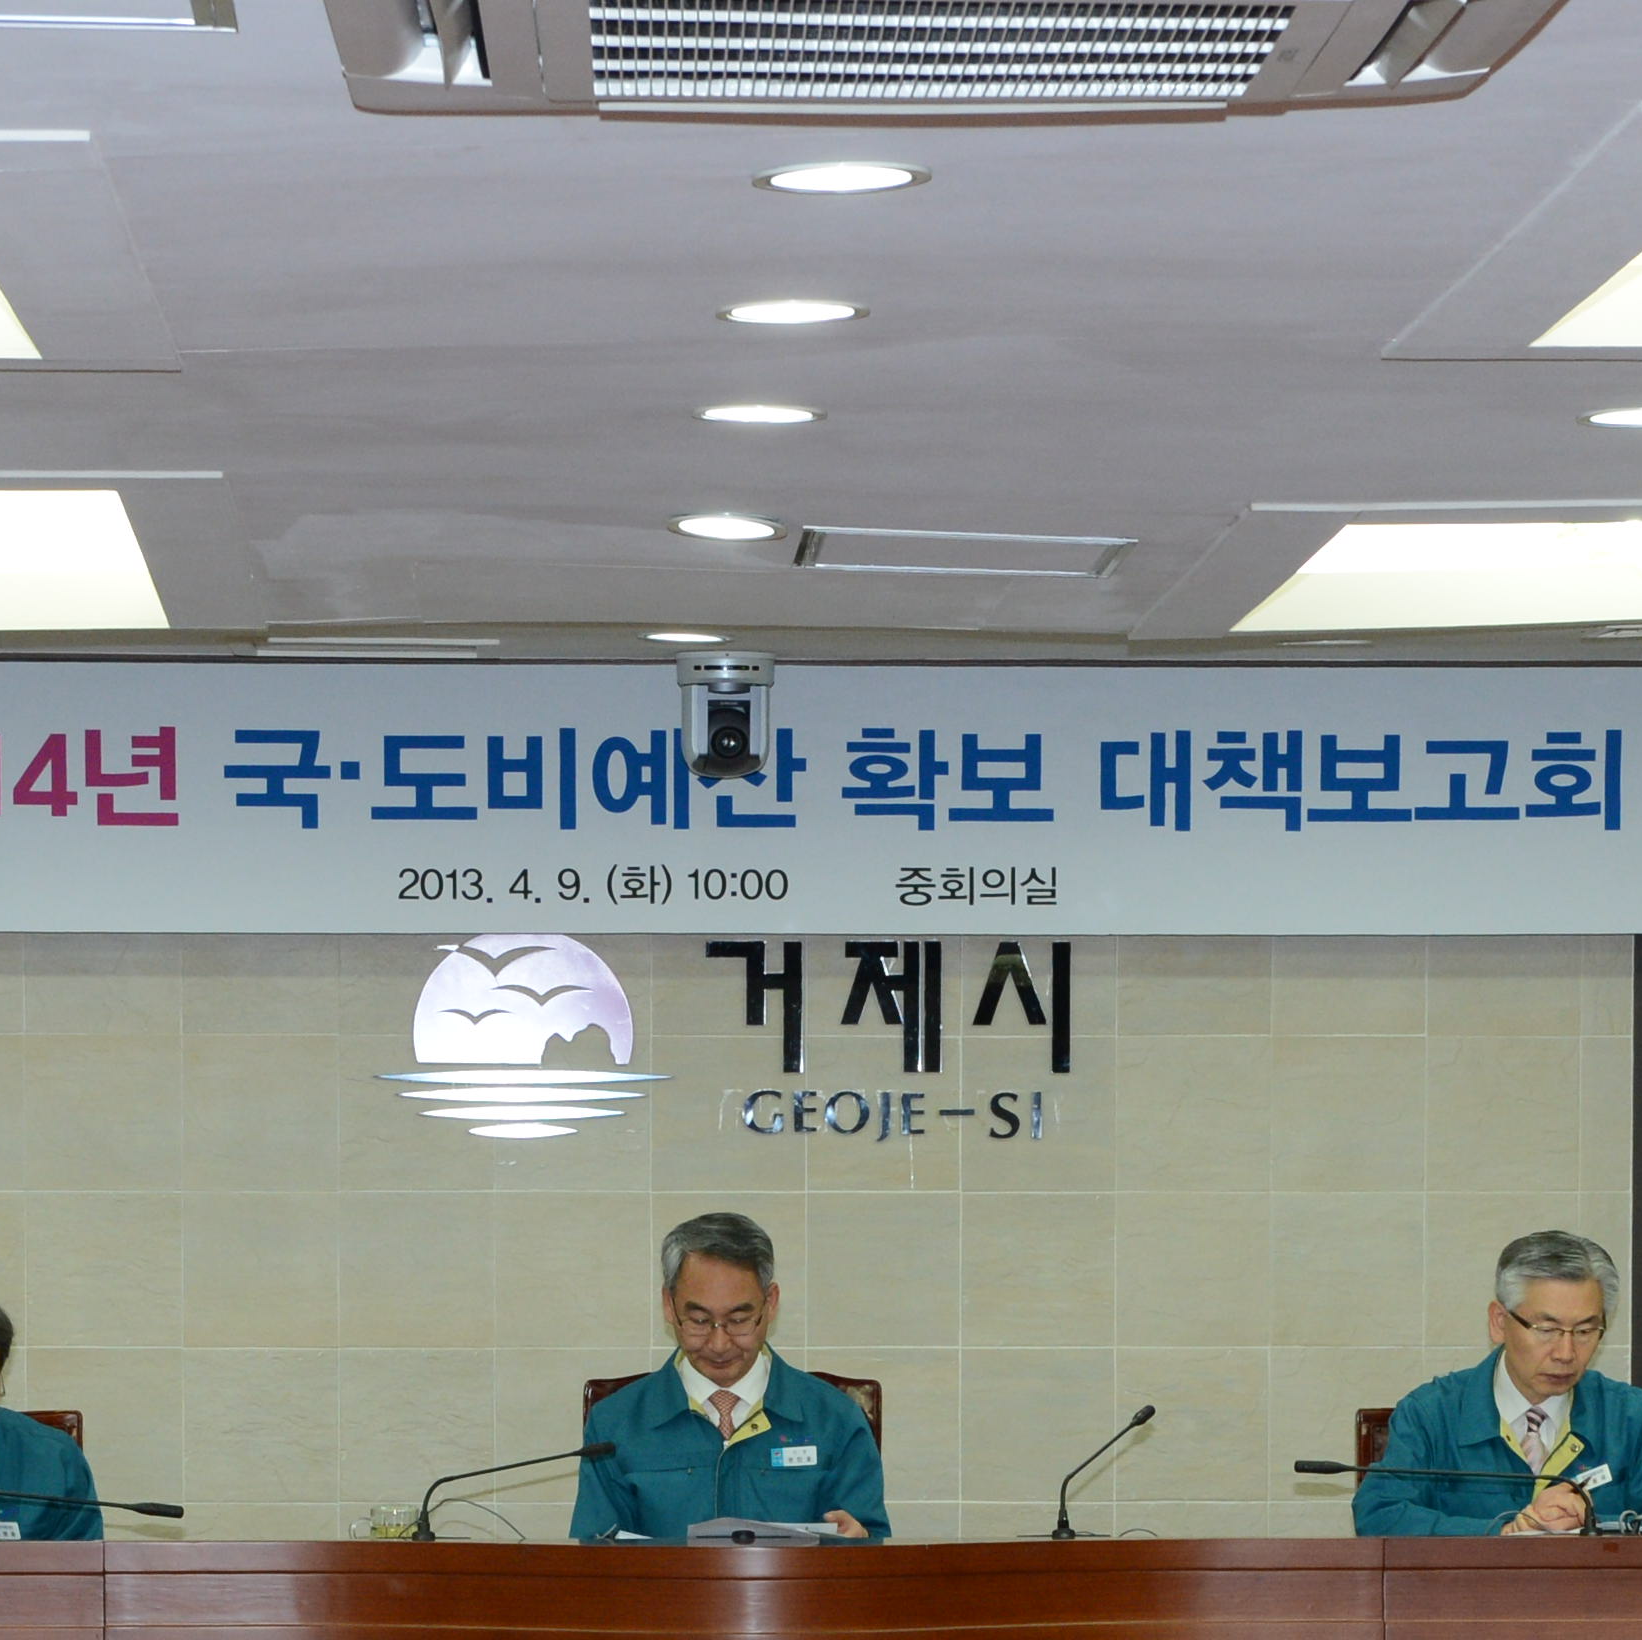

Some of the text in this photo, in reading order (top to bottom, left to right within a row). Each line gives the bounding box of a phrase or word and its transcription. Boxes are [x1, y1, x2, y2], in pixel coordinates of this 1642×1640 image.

[223, 727, 807, 831] 국·도비예산
[840, 727, 1055, 832] 확보
[1099, 729, 1623, 832] 대책보고회
[397, 863, 1059, 907] 2013. 4. 9. (화) 10:00 중회의실
[705, 940, 1072, 1074] 거제시
[741, 1089, 1044, 1142] GEOJE-SI
